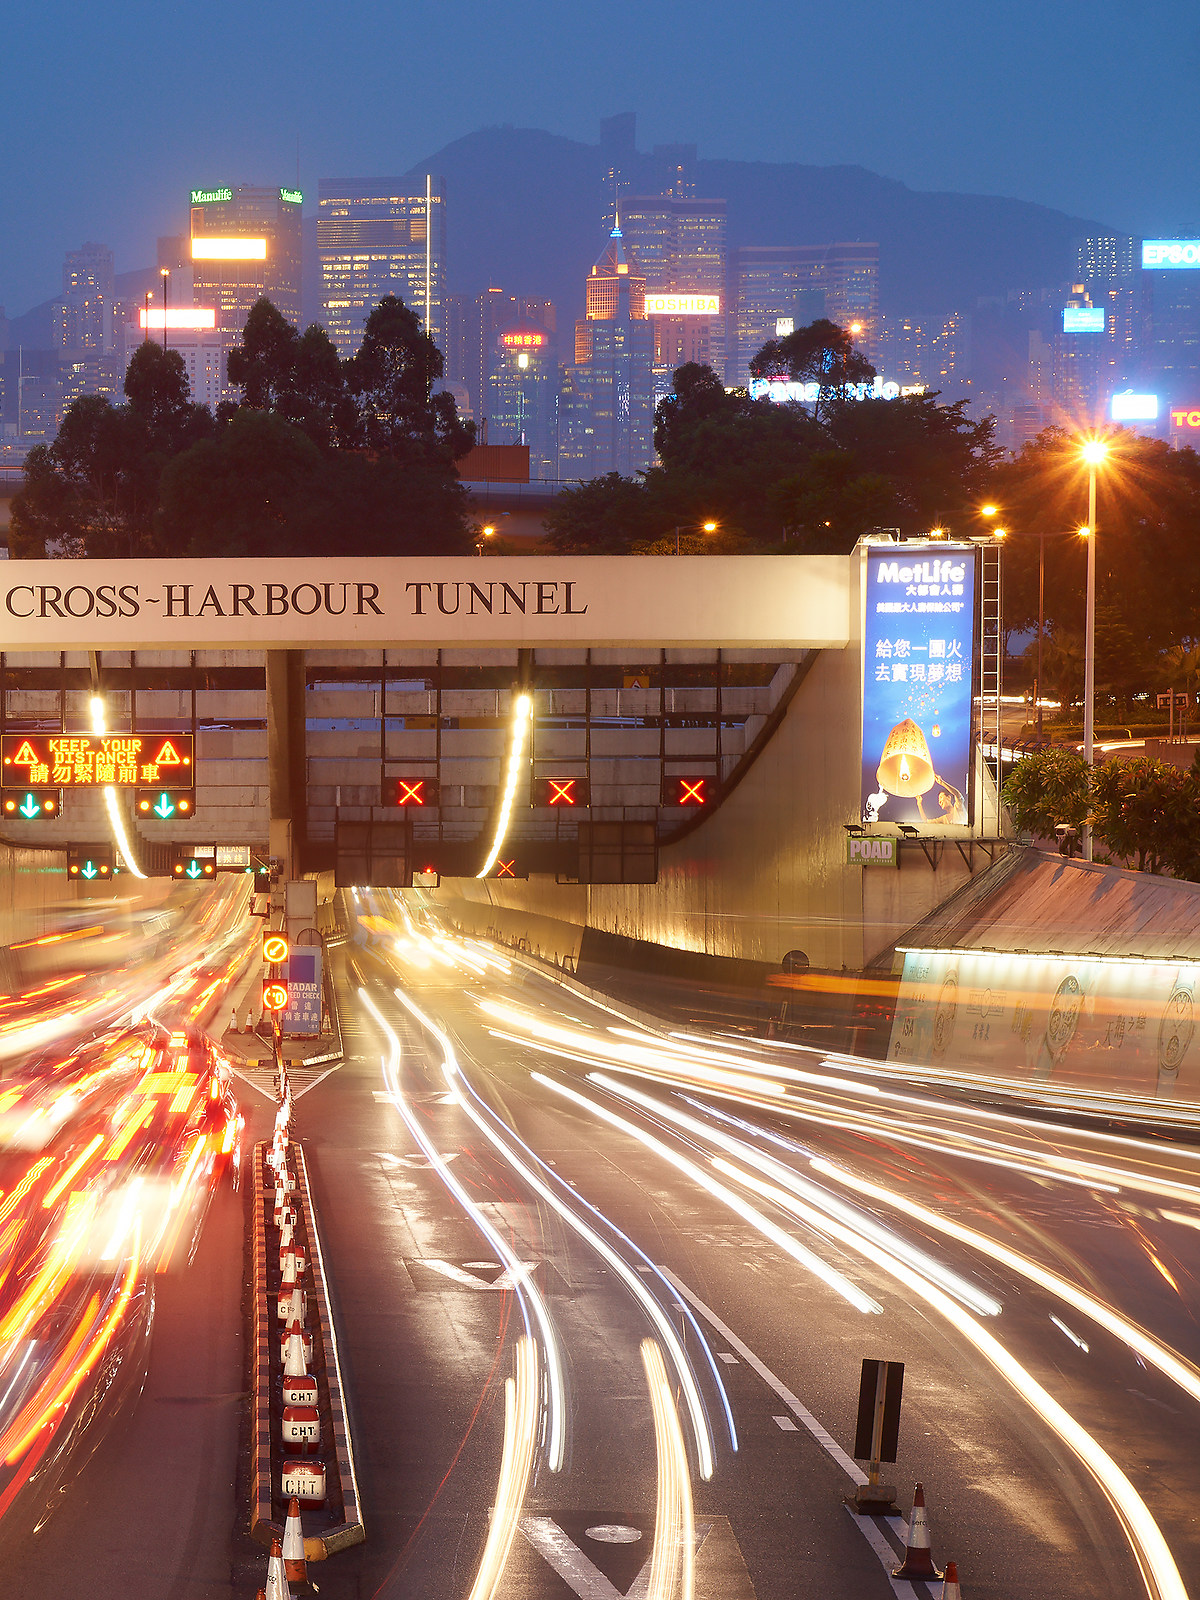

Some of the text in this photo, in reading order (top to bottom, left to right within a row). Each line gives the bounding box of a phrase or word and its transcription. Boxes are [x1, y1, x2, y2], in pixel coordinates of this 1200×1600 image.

[191, 188, 232, 203] Manulife
[1142, 245, 1200, 264] EPSO
[645, 299, 717, 311] TOSHIBA
[877, 560, 966, 583] MetLife
[5, 580, 589, 618] CROSS-HARBOUR TUNNEL
[49, 739, 142, 752] KEEP YOUR
[55, 751, 137, 764] DISTANCE
[29, 763, 161, 783] 請勿緊隨前車
[850, 840, 893, 859] POAD
[287, 982, 318, 991] RADAR
